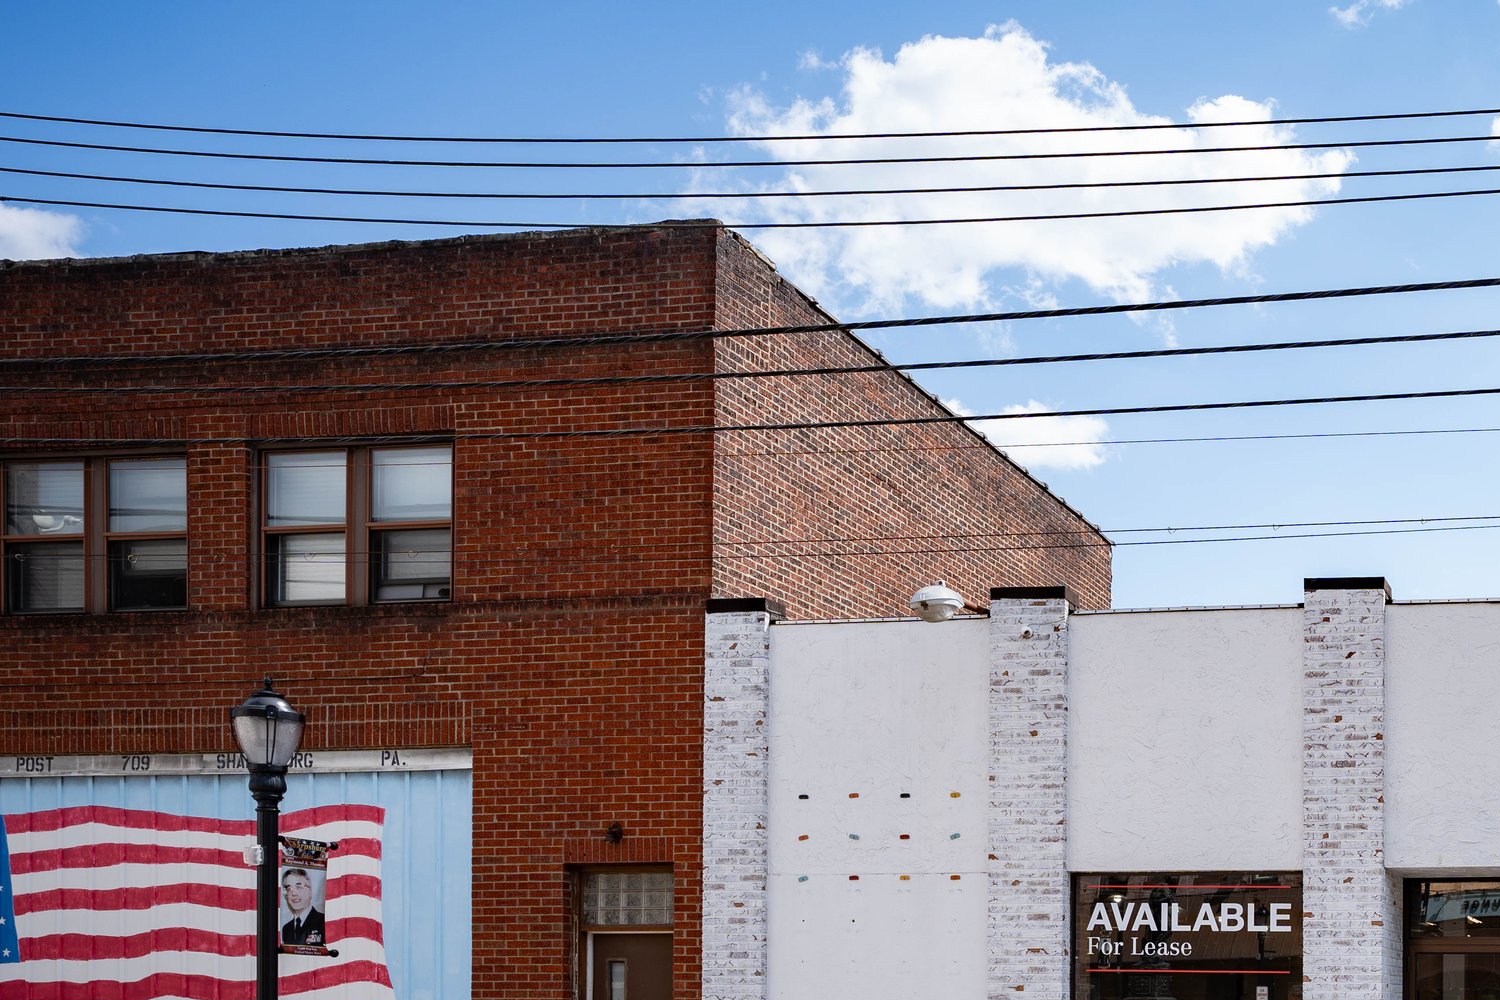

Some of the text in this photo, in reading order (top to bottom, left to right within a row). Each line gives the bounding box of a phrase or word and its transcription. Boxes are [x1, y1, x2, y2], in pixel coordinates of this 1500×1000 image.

[16, 750, 407, 773] POST 709 SHARG PA.
[1086, 902, 1292, 932] AVAILABLE
[1087, 936, 1192, 956] For Lease
